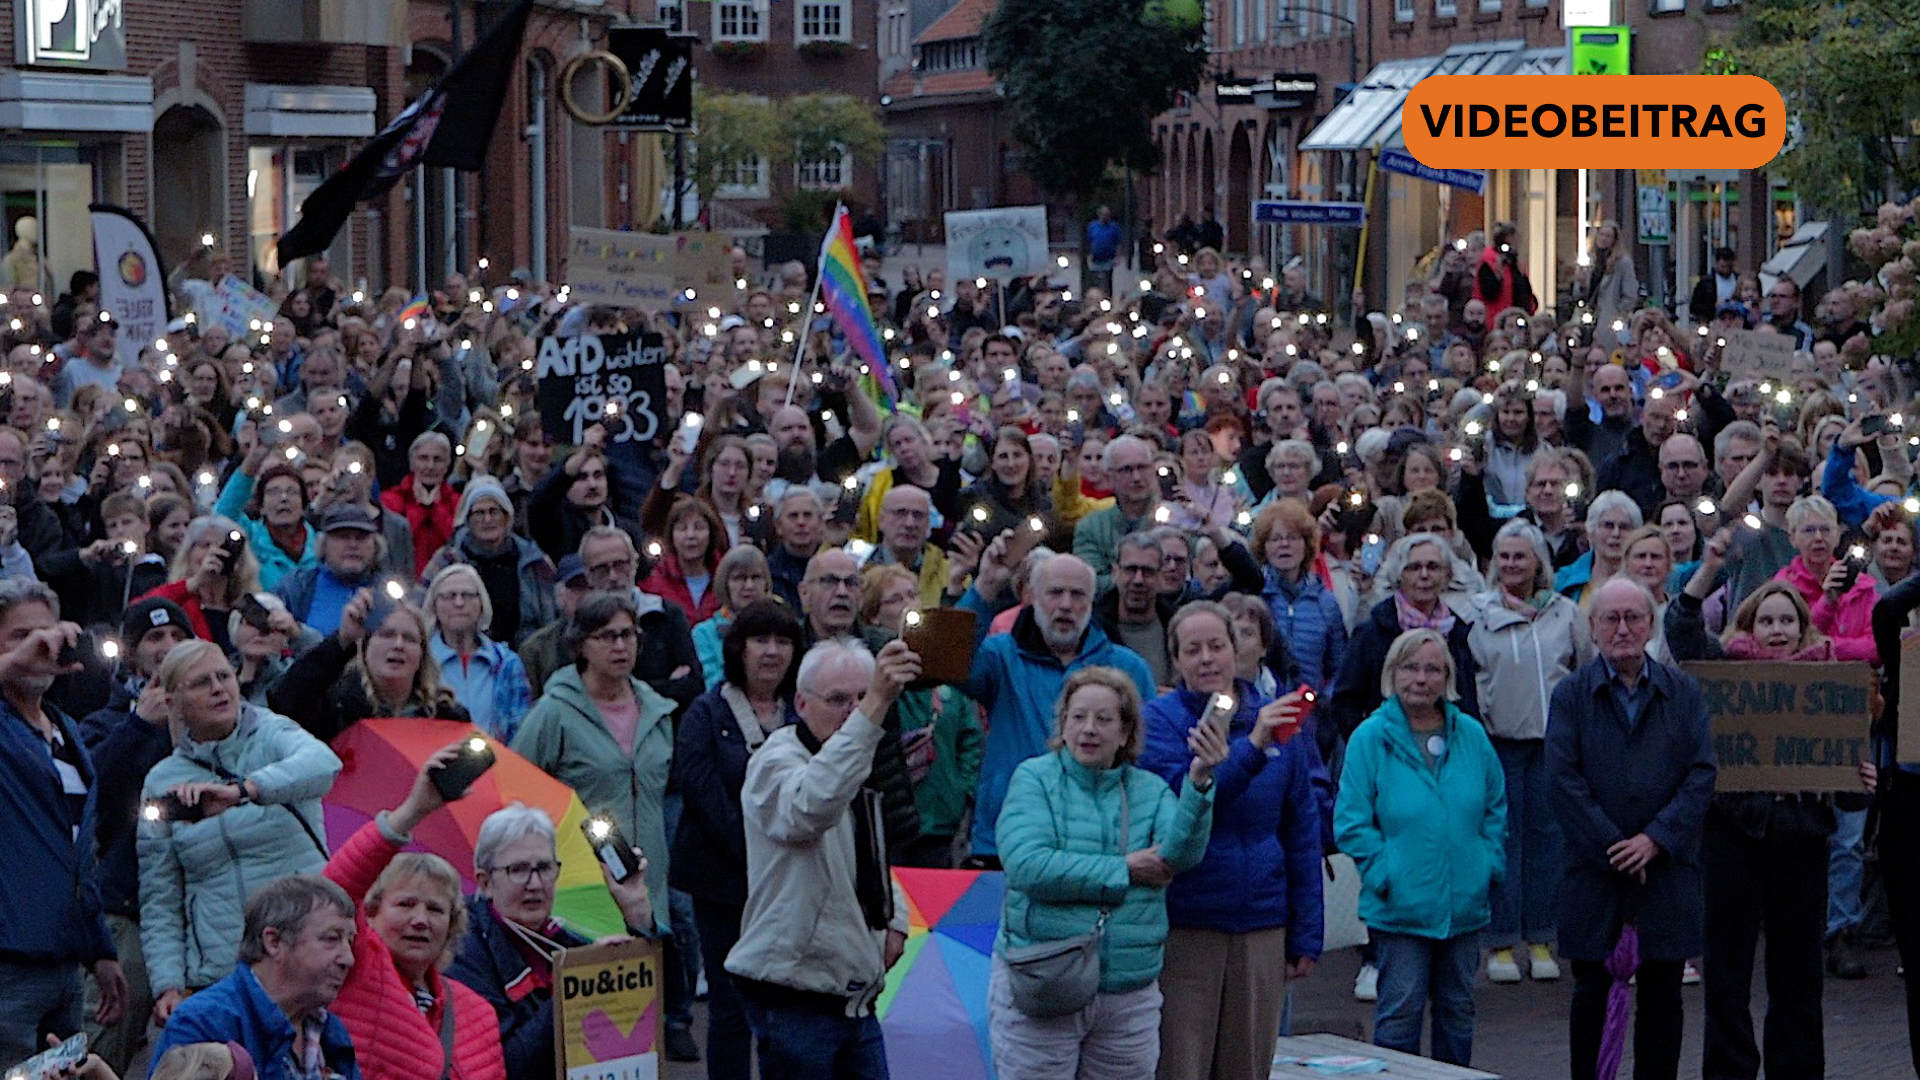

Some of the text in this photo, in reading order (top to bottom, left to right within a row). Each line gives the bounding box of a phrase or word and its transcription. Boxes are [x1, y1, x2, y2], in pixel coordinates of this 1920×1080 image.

[537, 335, 605, 378] AfD
[575, 373, 632, 394] ist so
[563, 961, 654, 1000] Du&ich
